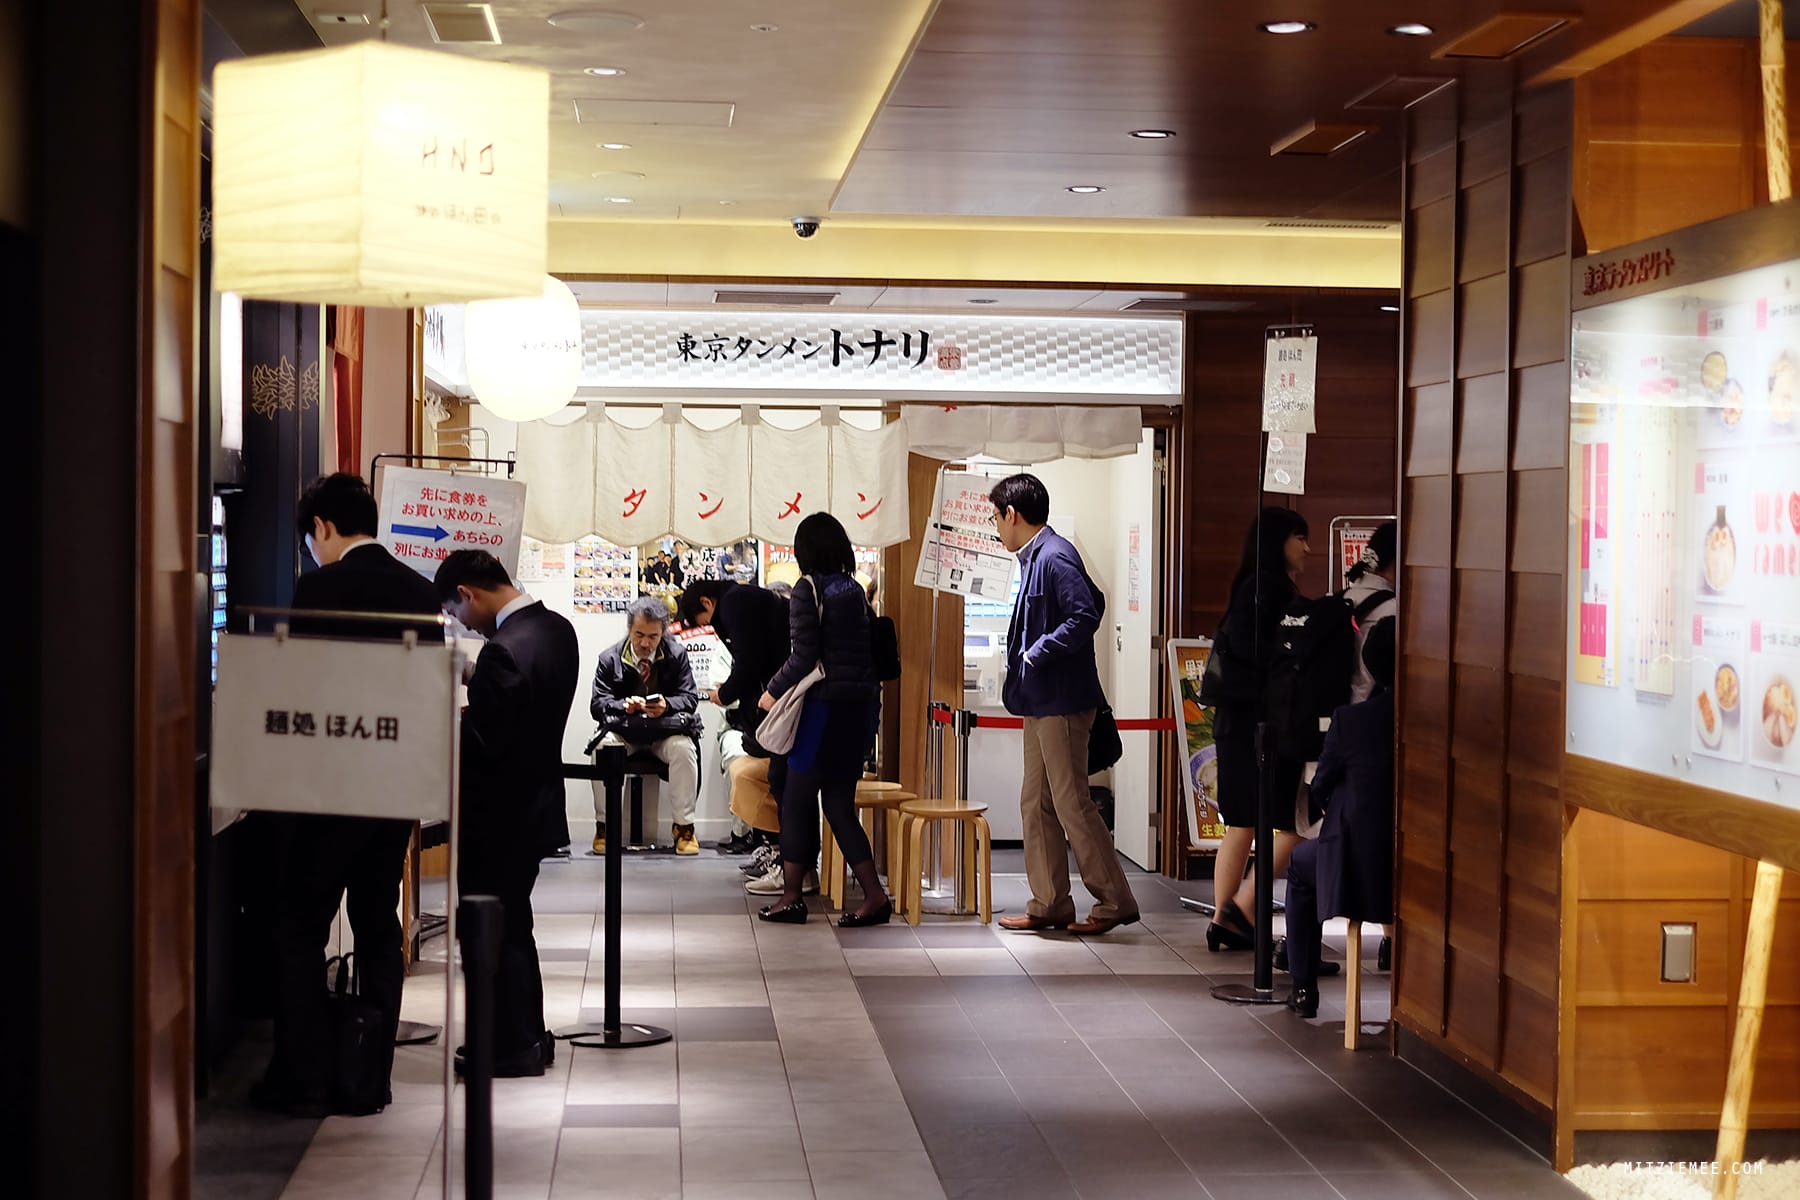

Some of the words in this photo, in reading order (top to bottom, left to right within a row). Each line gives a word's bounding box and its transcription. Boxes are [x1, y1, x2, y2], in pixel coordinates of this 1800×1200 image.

[676, 328, 930, 370] 東京タンメントナリ
[420, 487, 488, 507] 先に食券を
[453, 529, 504, 546] あちらの
[1753, 543, 1800, 577] rame
[326, 714, 399, 742] ほん田
